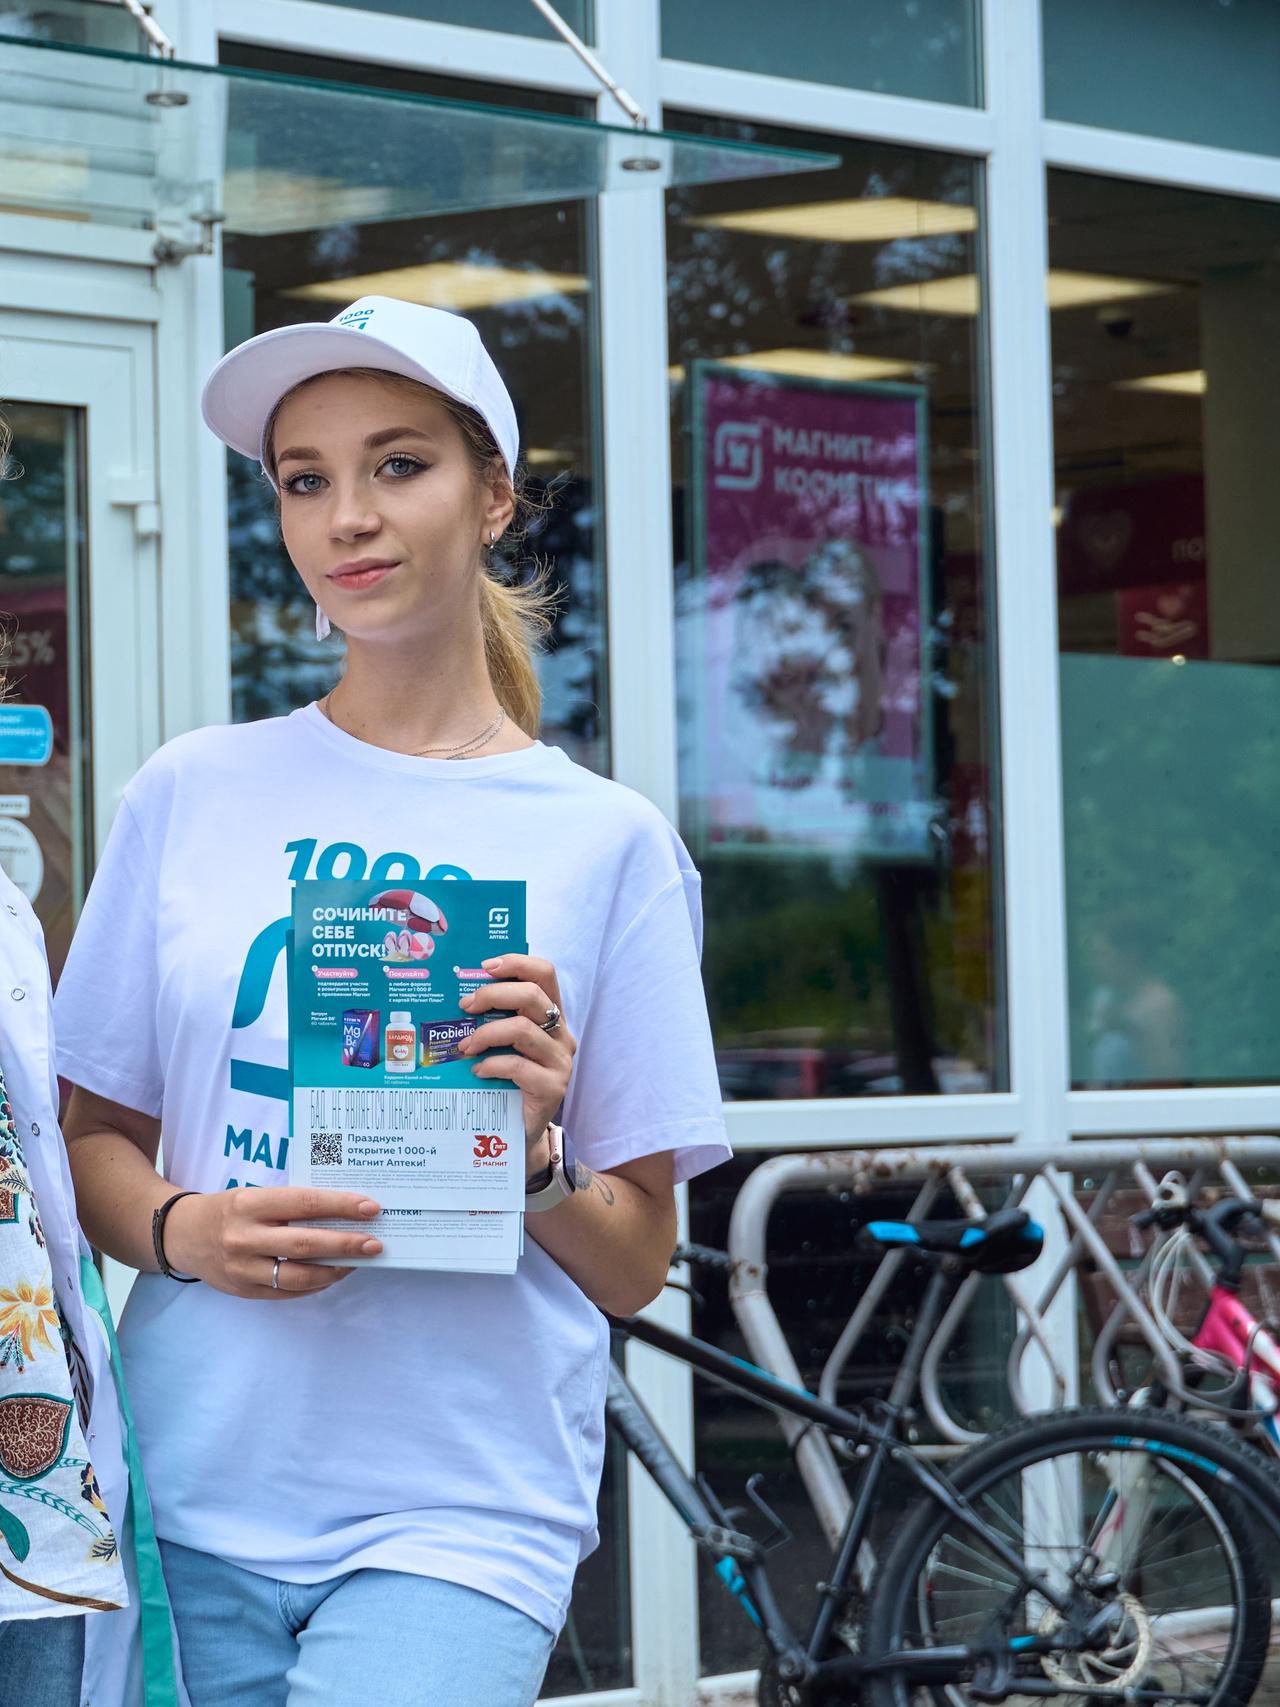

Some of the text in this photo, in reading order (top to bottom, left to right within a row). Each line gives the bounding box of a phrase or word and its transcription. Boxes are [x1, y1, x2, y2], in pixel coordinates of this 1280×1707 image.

[340, 308, 374, 322] 1000
[312, 907, 407, 922] СОЧИНИТЕ
[312, 925, 355, 939] СЕБЕ
[312, 943, 386, 957] ОТПУСК!
[344, 1025, 360, 1038] Mg
[429, 1026, 475, 1040] Probielle
[346, 1035, 357, 1047] B6
[332, 1090, 342, 1129] НЕ
[345, 1090, 385, 1130] ЯВЛЯЕТСЯ
[388, 1090, 458, 1131] ЛЕКАРСТВЕННЫМ
[462, 1091, 508, 1132] СРЕДСТВОМ
[348, 1134, 404, 1143] Празднуем
[348, 1158, 426, 1168] Магнит Аптеки!
